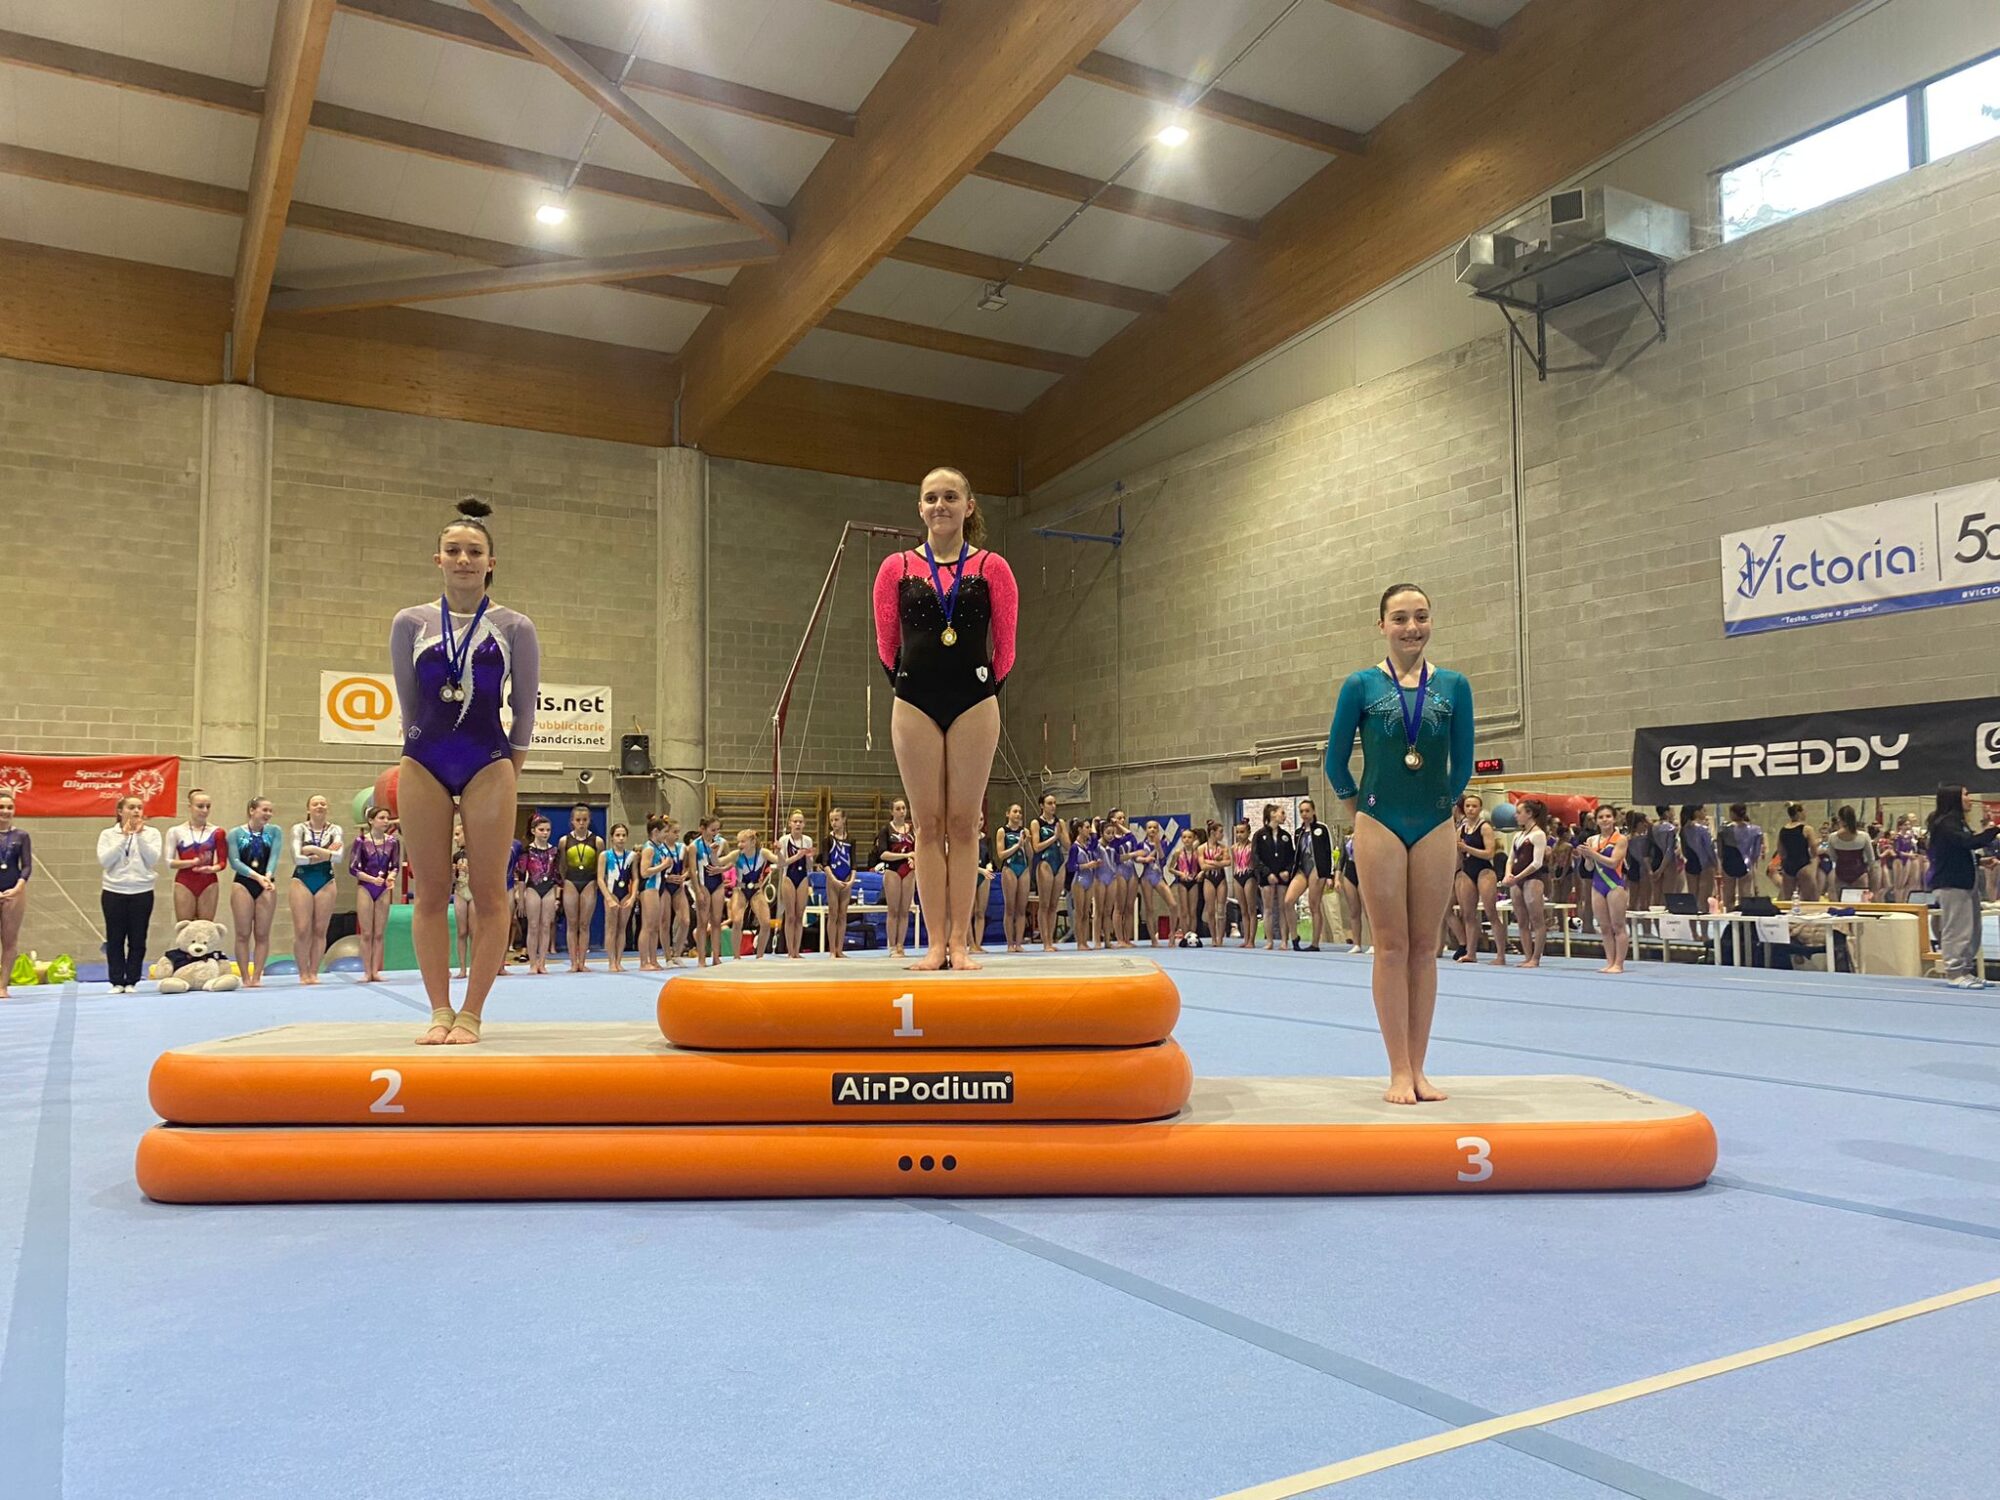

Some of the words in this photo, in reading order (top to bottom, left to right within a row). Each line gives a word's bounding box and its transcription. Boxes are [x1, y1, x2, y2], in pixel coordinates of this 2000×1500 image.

[1737, 534, 1916, 599] Victoria
[75, 769, 124, 780] Special
[1701, 733, 1909, 780] FREDDY
[62, 779, 124, 791] Olympics
[892, 993, 923, 1037] 1
[369, 1068, 405, 1113] 2
[1455, 1136, 1494, 1182] 3
